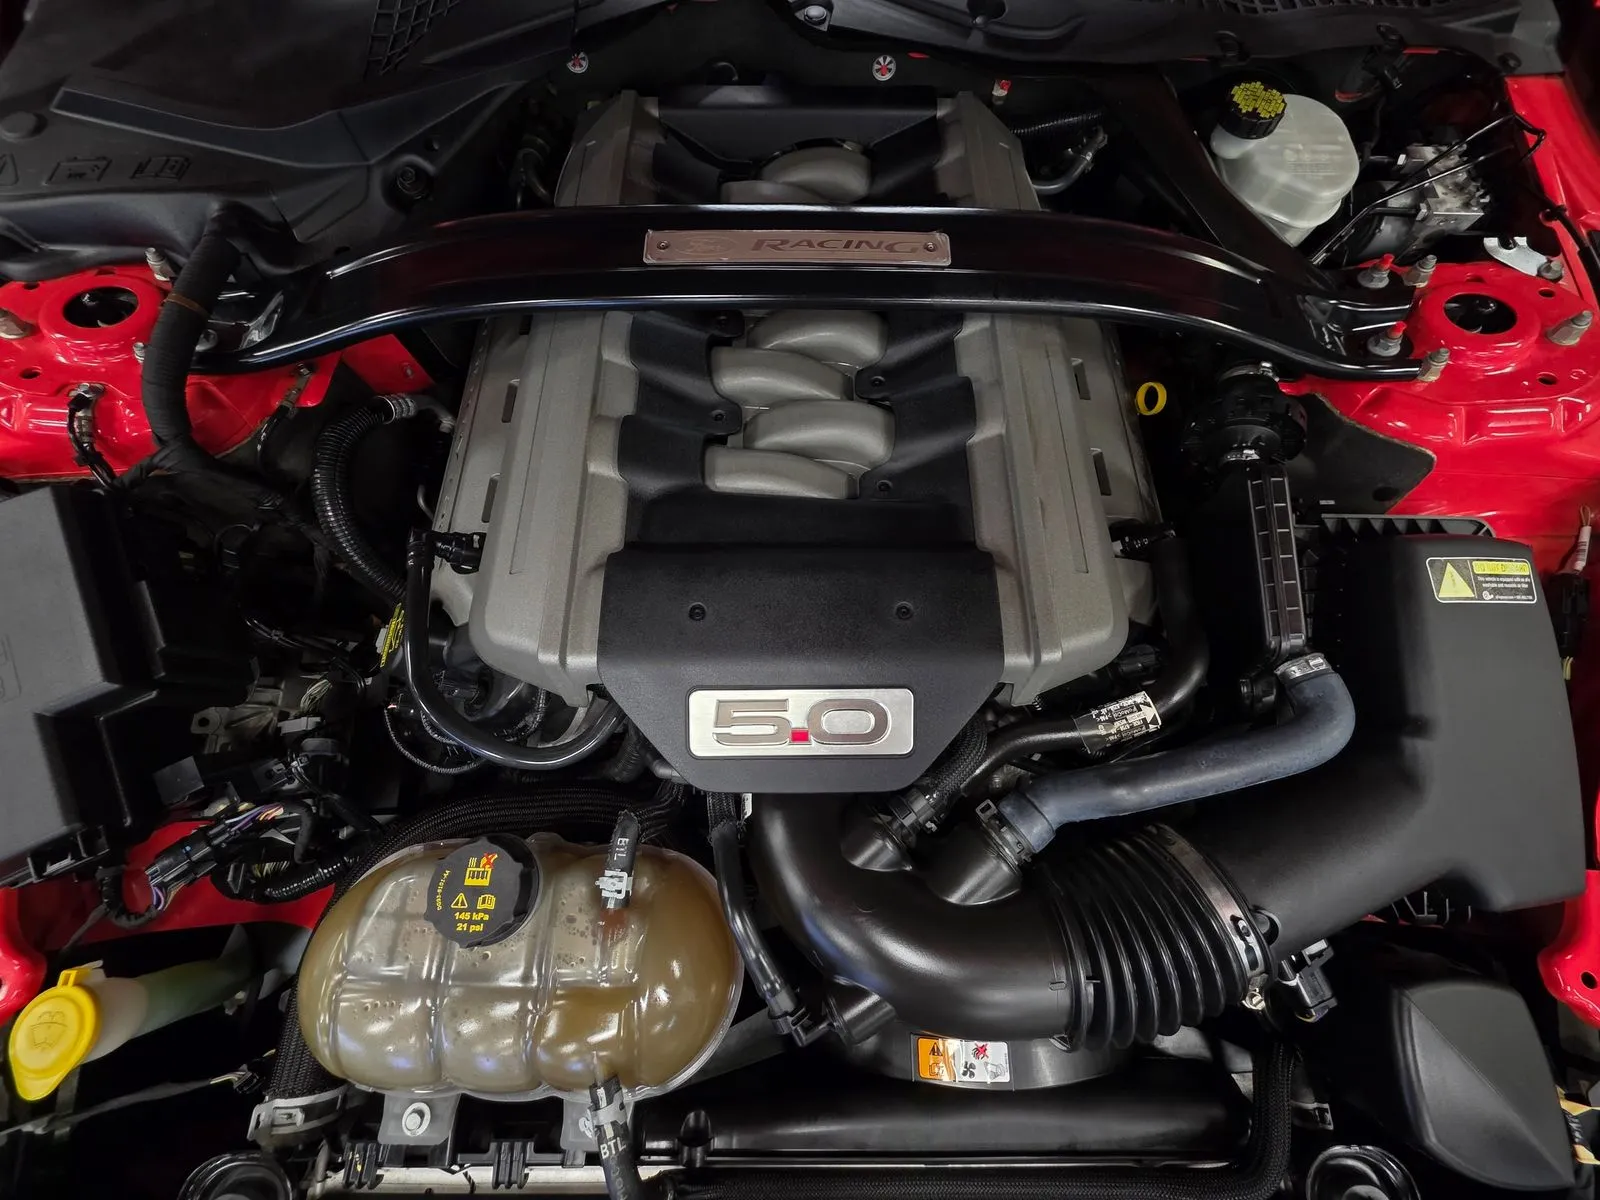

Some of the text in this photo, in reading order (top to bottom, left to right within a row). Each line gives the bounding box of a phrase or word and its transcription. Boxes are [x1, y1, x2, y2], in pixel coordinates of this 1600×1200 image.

[751, 238, 922, 254] RACING
[712, 699, 892, 747] 5.0
[454, 912, 489, 921] 145 kPa
[456, 923, 484, 933] 21 psi
[600, 1136, 627, 1160] BTL
